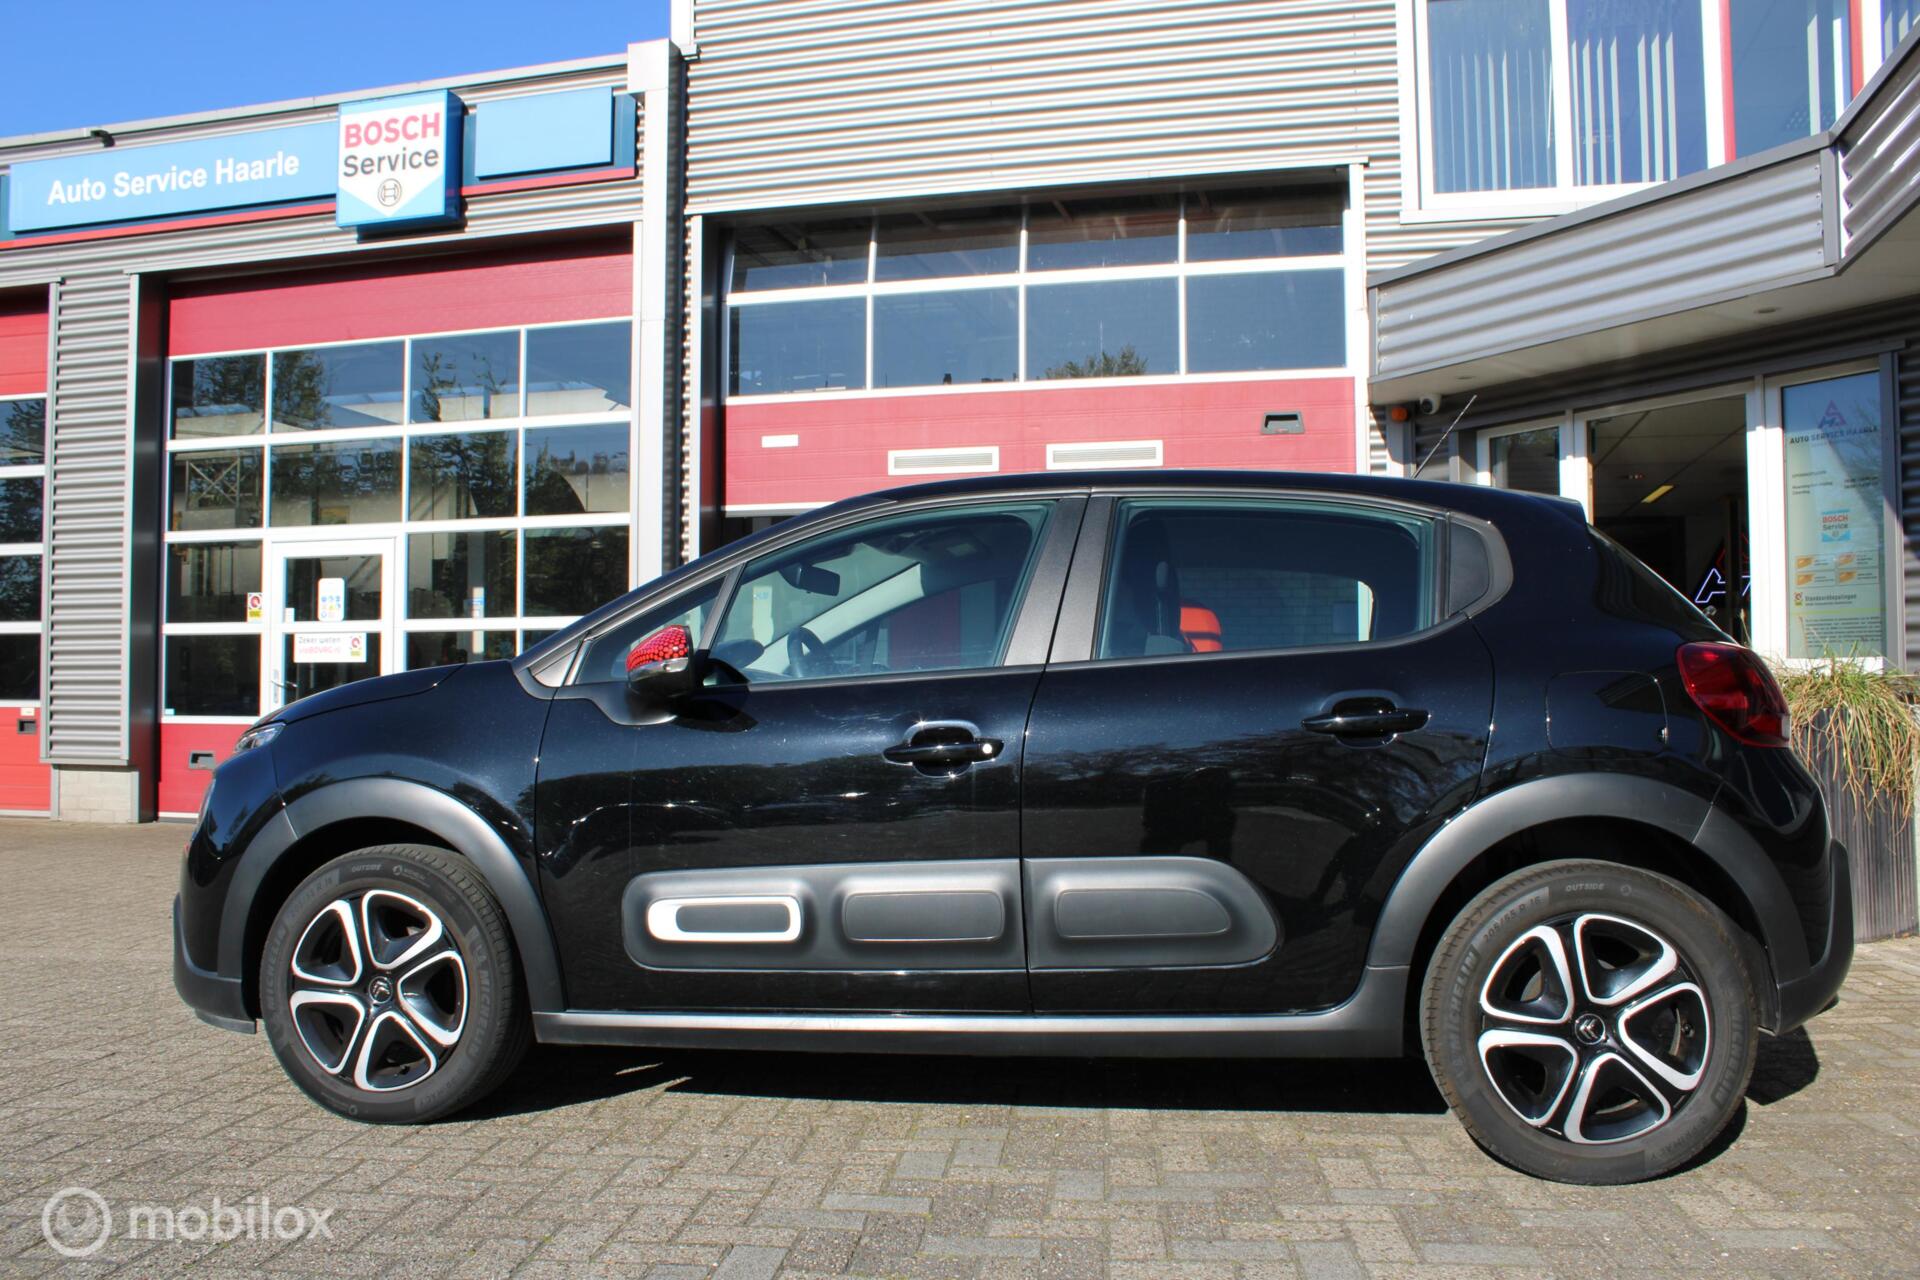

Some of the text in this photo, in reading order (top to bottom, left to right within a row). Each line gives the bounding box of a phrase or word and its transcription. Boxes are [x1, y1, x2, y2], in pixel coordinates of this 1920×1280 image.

[344, 112, 440, 149] BOSCH
[343, 146, 439, 177] Service
[47, 151, 300, 205] Auto Service Haarle
[1790, 435, 1809, 444] AUTO
[1822, 514, 1849, 524] BOSCH
[1822, 523, 1849, 531] Service
[1565, 882, 1605, 893] OUTSIDE
[1446, 949, 1479, 1053] MICHELIN
